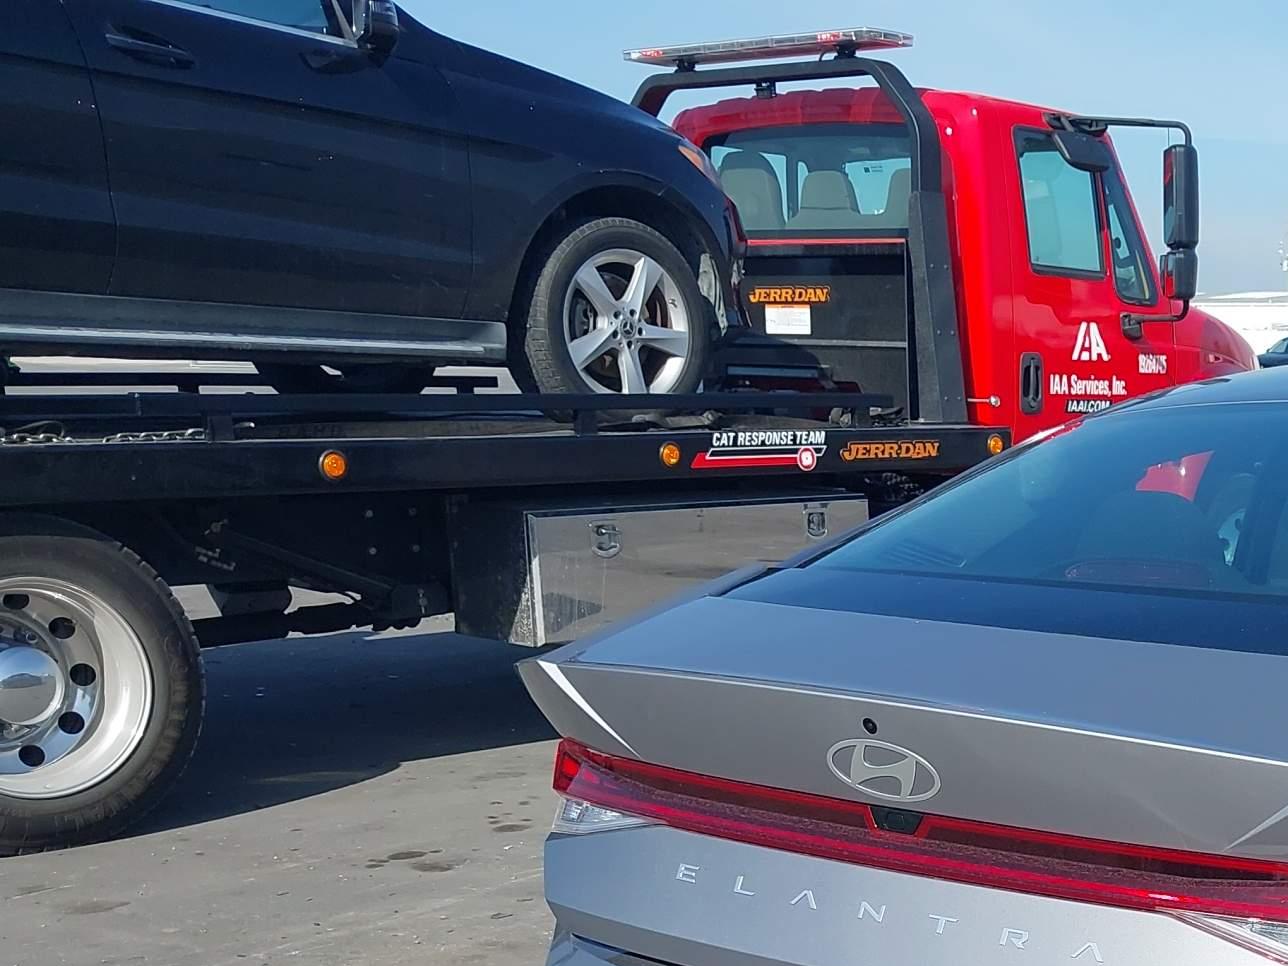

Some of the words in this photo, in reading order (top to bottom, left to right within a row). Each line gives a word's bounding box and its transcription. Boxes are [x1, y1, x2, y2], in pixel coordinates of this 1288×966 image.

[1049, 373, 1069, 395] IAA
[1070, 373, 1111, 397] Services,
[1112, 374, 1127, 395] Inc.
[712, 432, 736, 446] CAT
[737, 431, 794, 446] RESPONSE
[795, 430, 826, 445] TEAM
[675, 863, 1104, 963] ELANTRA
